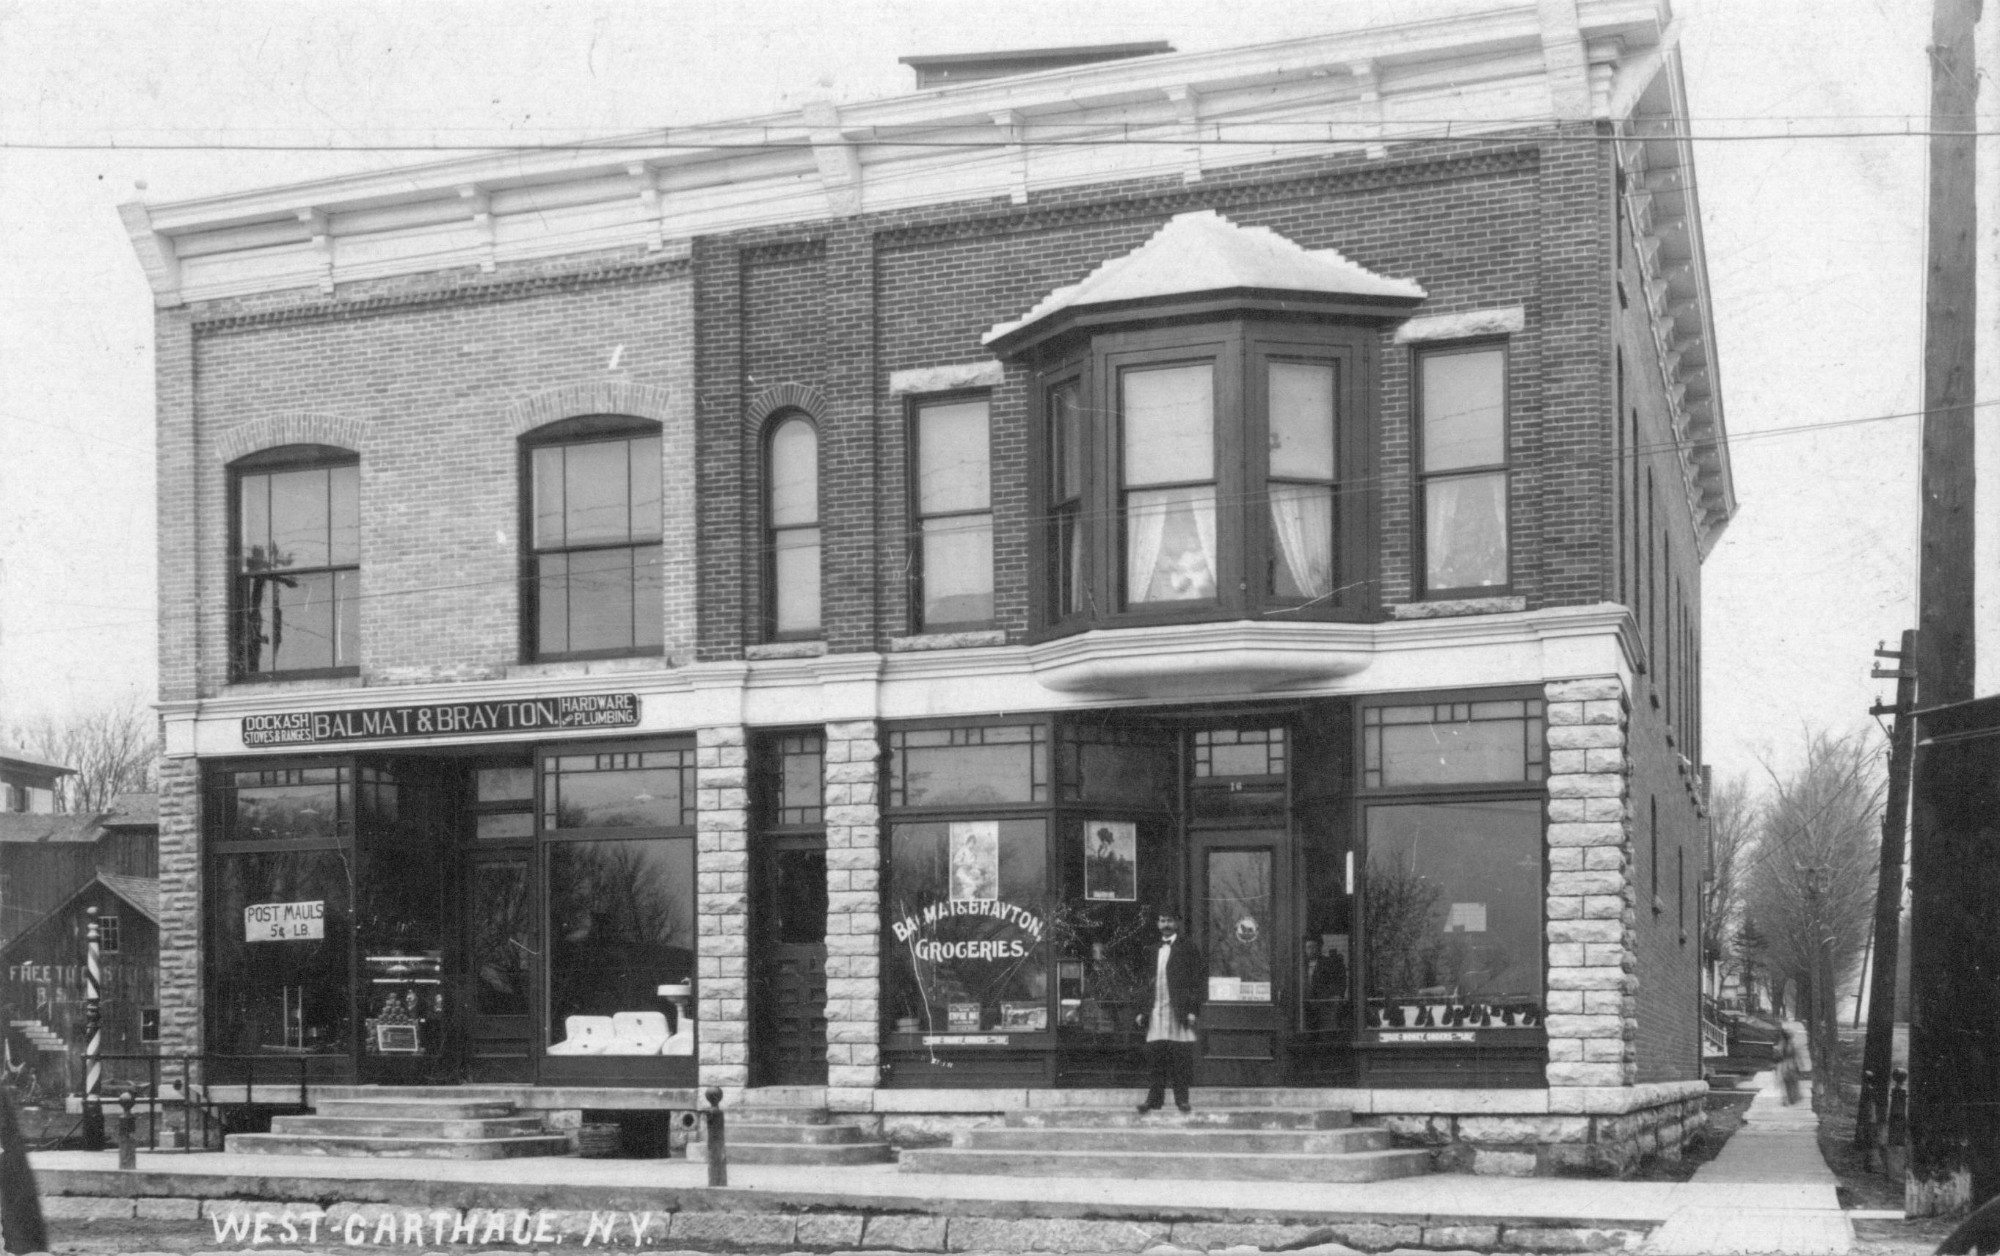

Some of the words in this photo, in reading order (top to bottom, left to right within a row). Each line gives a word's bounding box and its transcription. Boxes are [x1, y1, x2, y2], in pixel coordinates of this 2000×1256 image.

[561, 694, 633, 712] HARDWARE
[246, 713, 309, 730] DOCKASH
[314, 709, 412, 738] BALMAT
[417, 708, 434, 732] &
[436, 701, 558, 731] BRAYTON.
[244, 731, 274, 744] STOVES
[248, 905, 280, 922] POST
[284, 903, 324, 920] MAULS
[915, 939, 1029, 962] GROCERIES.
